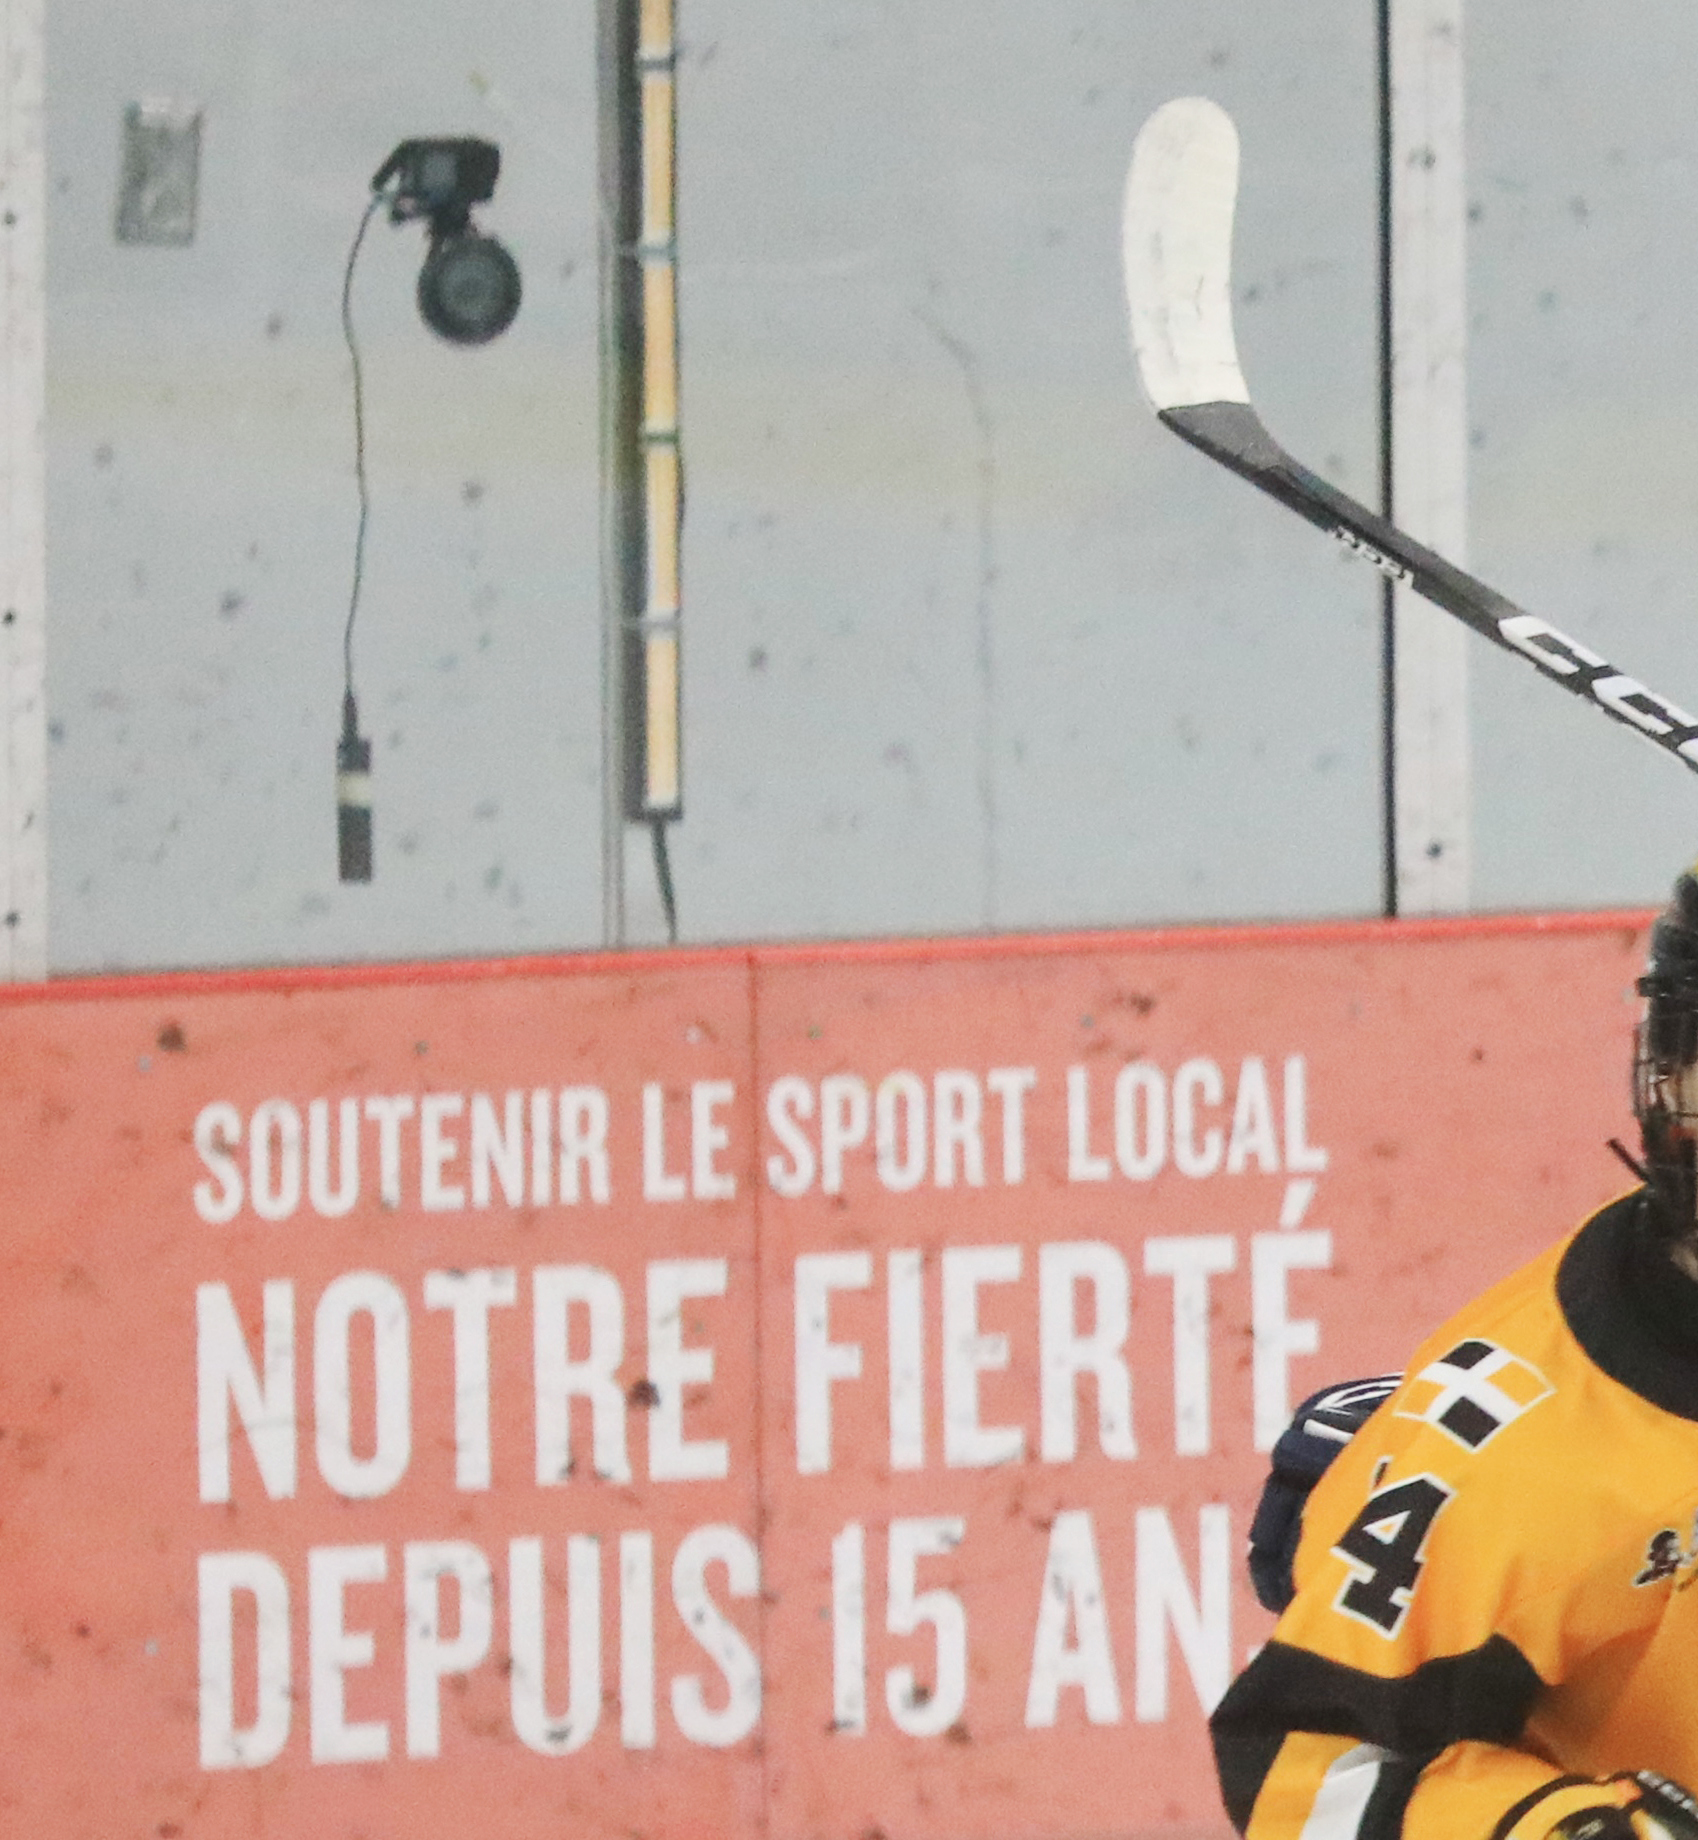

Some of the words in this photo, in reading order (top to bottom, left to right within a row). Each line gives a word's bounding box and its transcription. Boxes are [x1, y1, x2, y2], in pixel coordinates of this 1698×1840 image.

[193, 1083, 610, 1223] SOUTENIR
[642, 1081, 735, 1200] LE
[767, 1066, 1036, 1197] SPORT
[1067, 1055, 1328, 1182] LOCAL
[196, 1258, 731, 1503] NOTRE
[795, 1179, 1333, 1475] FIERTÉ
[198, 1525, 764, 1771] DEPUIS
[831, 1515, 968, 1738] 15
[1024, 1505, 1268, 1729] AN
[1331, 1456, 1458, 1642] 4
